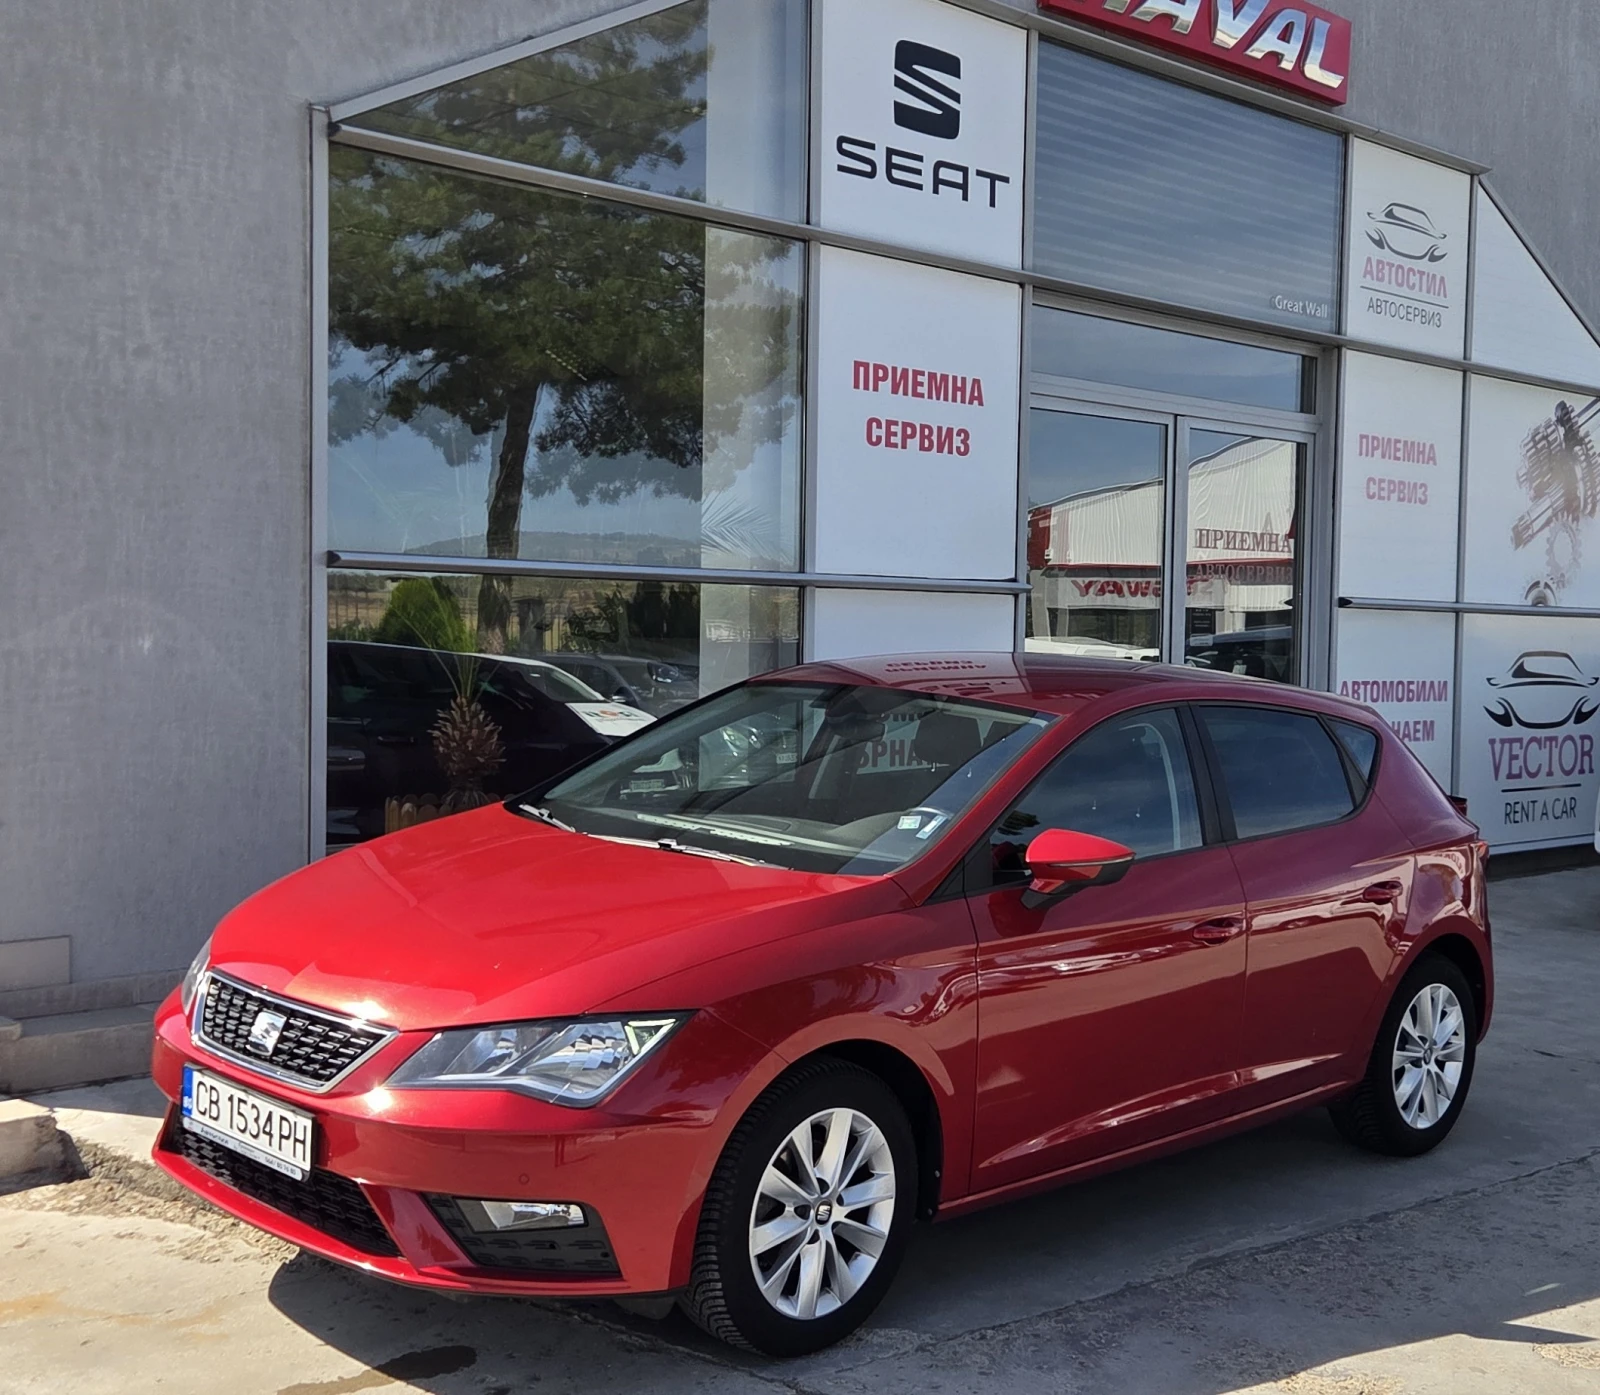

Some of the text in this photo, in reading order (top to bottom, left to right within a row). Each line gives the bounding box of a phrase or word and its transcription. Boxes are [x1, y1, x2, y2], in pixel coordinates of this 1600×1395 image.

[1084, 0, 1345, 89] AVAL
[836, 135, 1010, 208] SEAT
[1362, 256, 1448, 299] АВТОСТИЛ
[1275, 295, 1328, 318] Great Wall
[1367, 297, 1442, 328] АВТОСЕРВИЗ
[853, 360, 984, 407] ПРИЕМНА
[866, 417, 970, 457] СЕРВИЗ
[1358, 433, 1437, 466] ПРИЕМНА
[1366, 476, 1428, 505] СЕРВИЗ
[1194, 528, 1292, 553] ПРИЕМНА
[1340, 680, 1448, 703] АВТОМОБИЛИ
[1488, 734, 1594, 781] VECTOR
[1504, 797, 1577, 825] RENT A CAR
[228, 1094, 273, 1147] 1534
